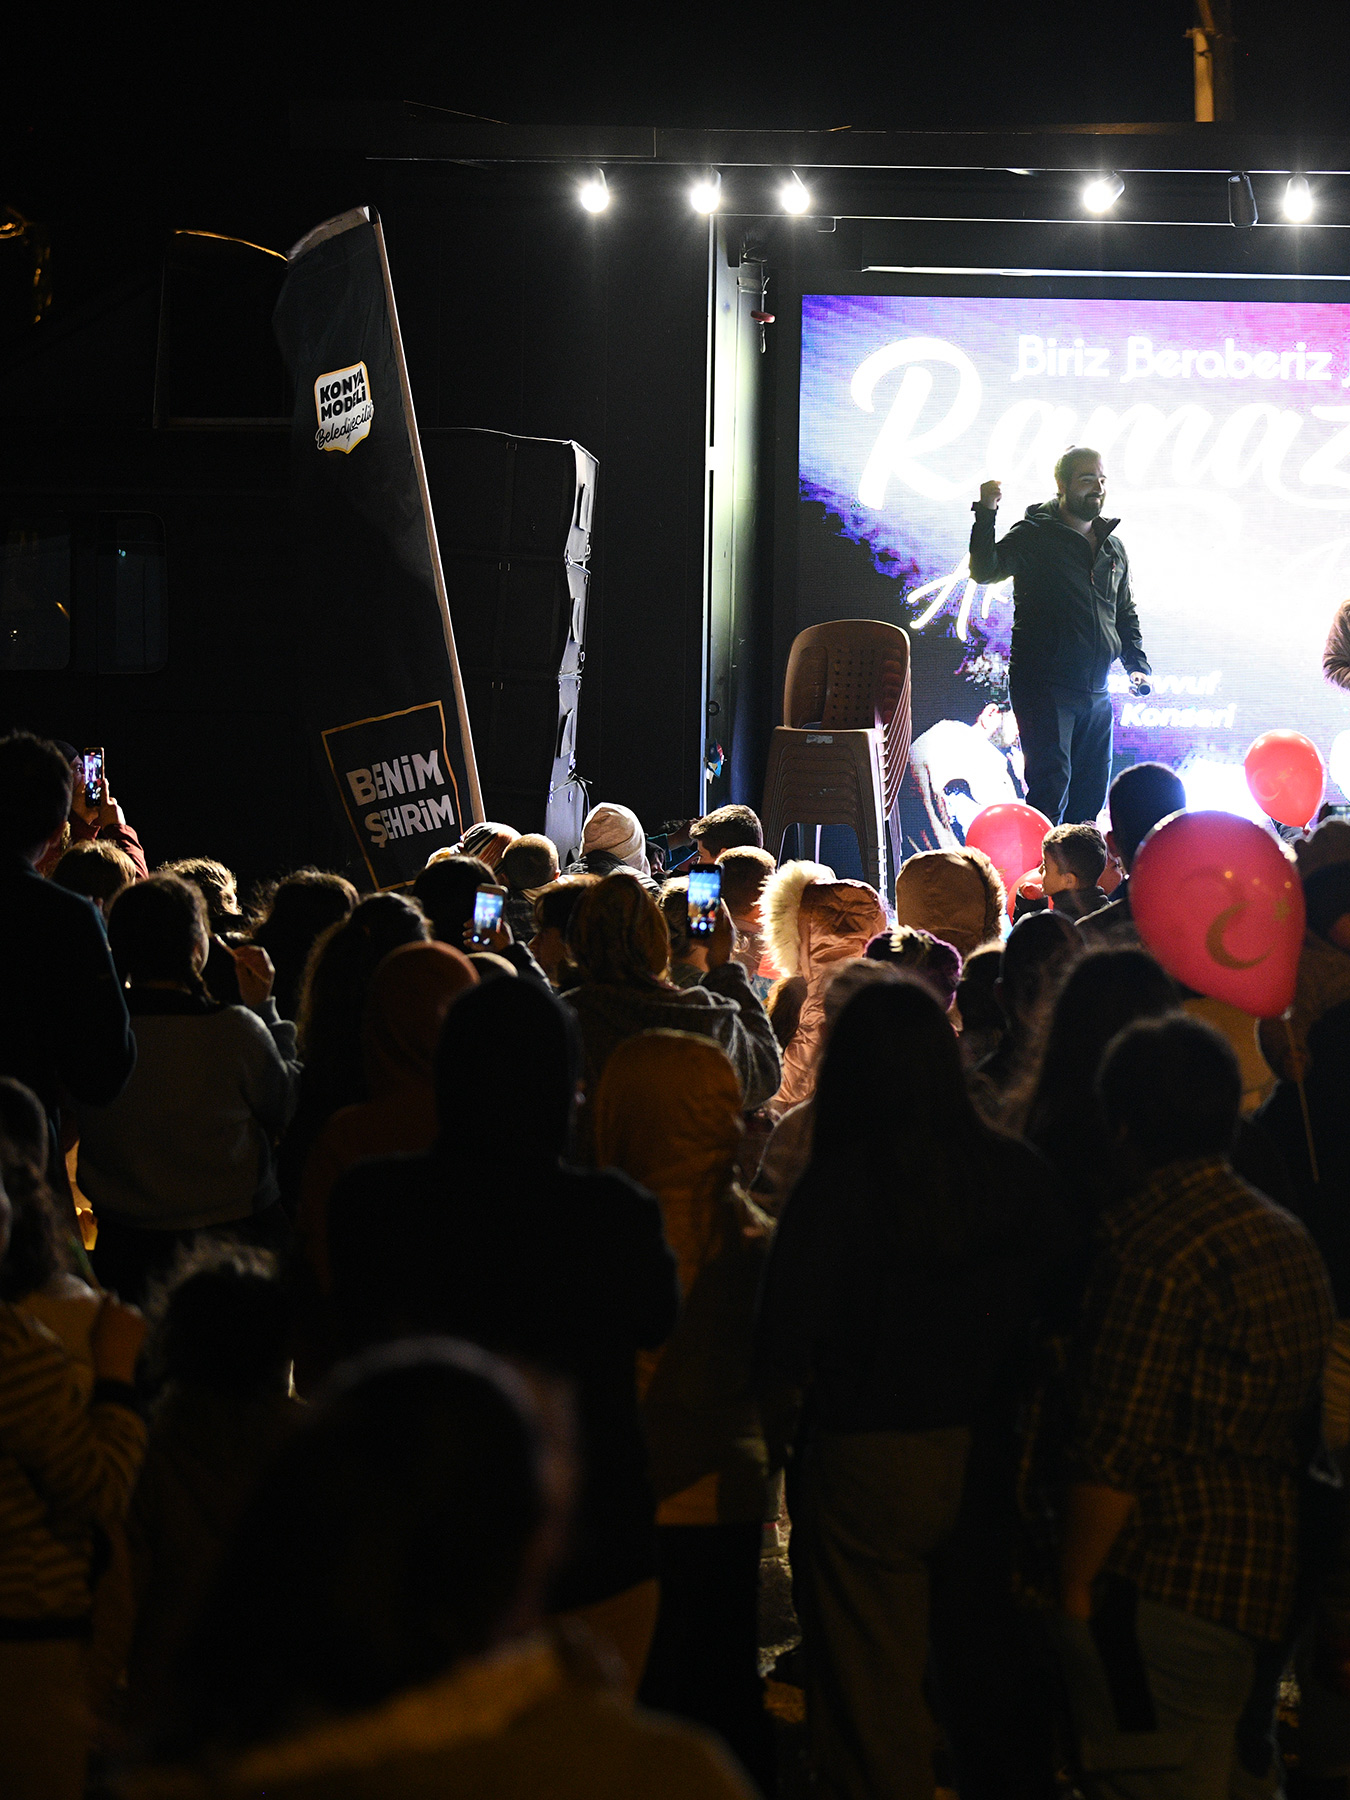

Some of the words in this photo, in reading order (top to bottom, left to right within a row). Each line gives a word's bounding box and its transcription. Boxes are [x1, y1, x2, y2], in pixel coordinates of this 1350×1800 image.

[1010, 334, 1110, 381] Biriz
[1119, 336, 1333, 384] Beraberiz
[319, 368, 365, 405] KONYA
